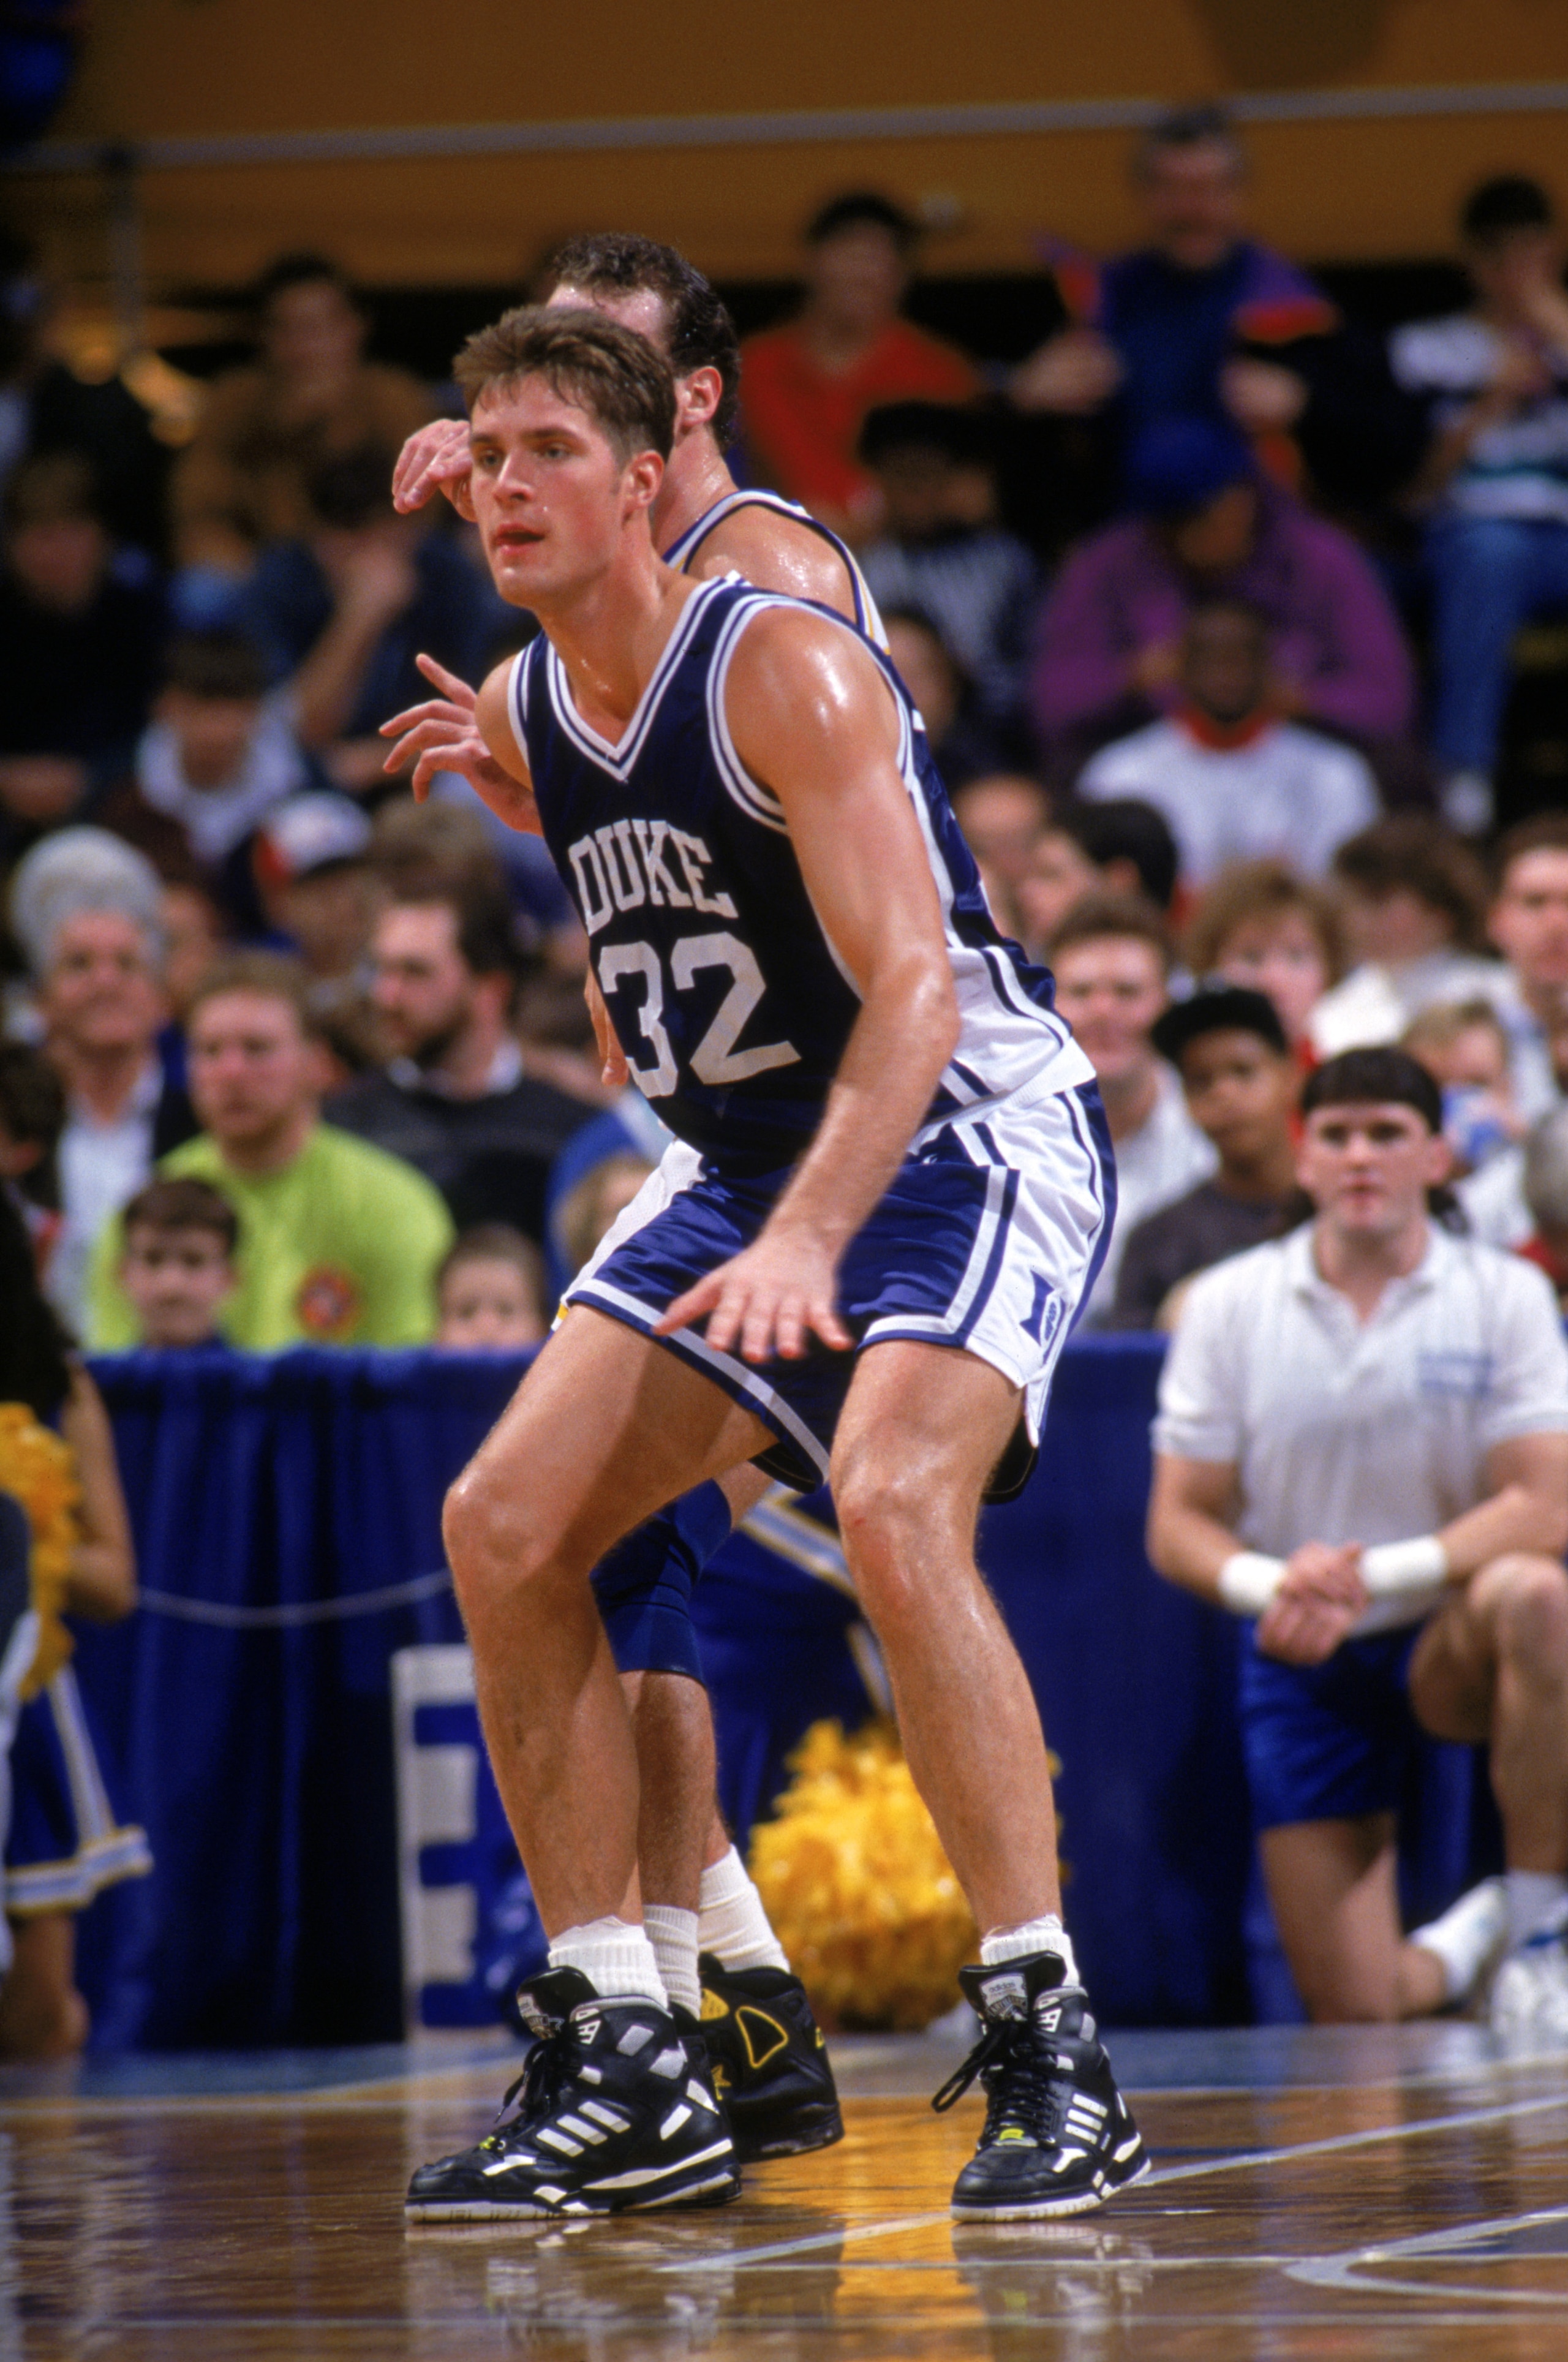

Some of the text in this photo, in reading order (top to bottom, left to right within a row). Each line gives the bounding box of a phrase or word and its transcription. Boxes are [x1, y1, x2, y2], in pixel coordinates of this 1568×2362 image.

[568, 819, 738, 937] DUKE
[599, 932, 801, 1098] 32
[989, 1981, 1016, 1993] adidas
